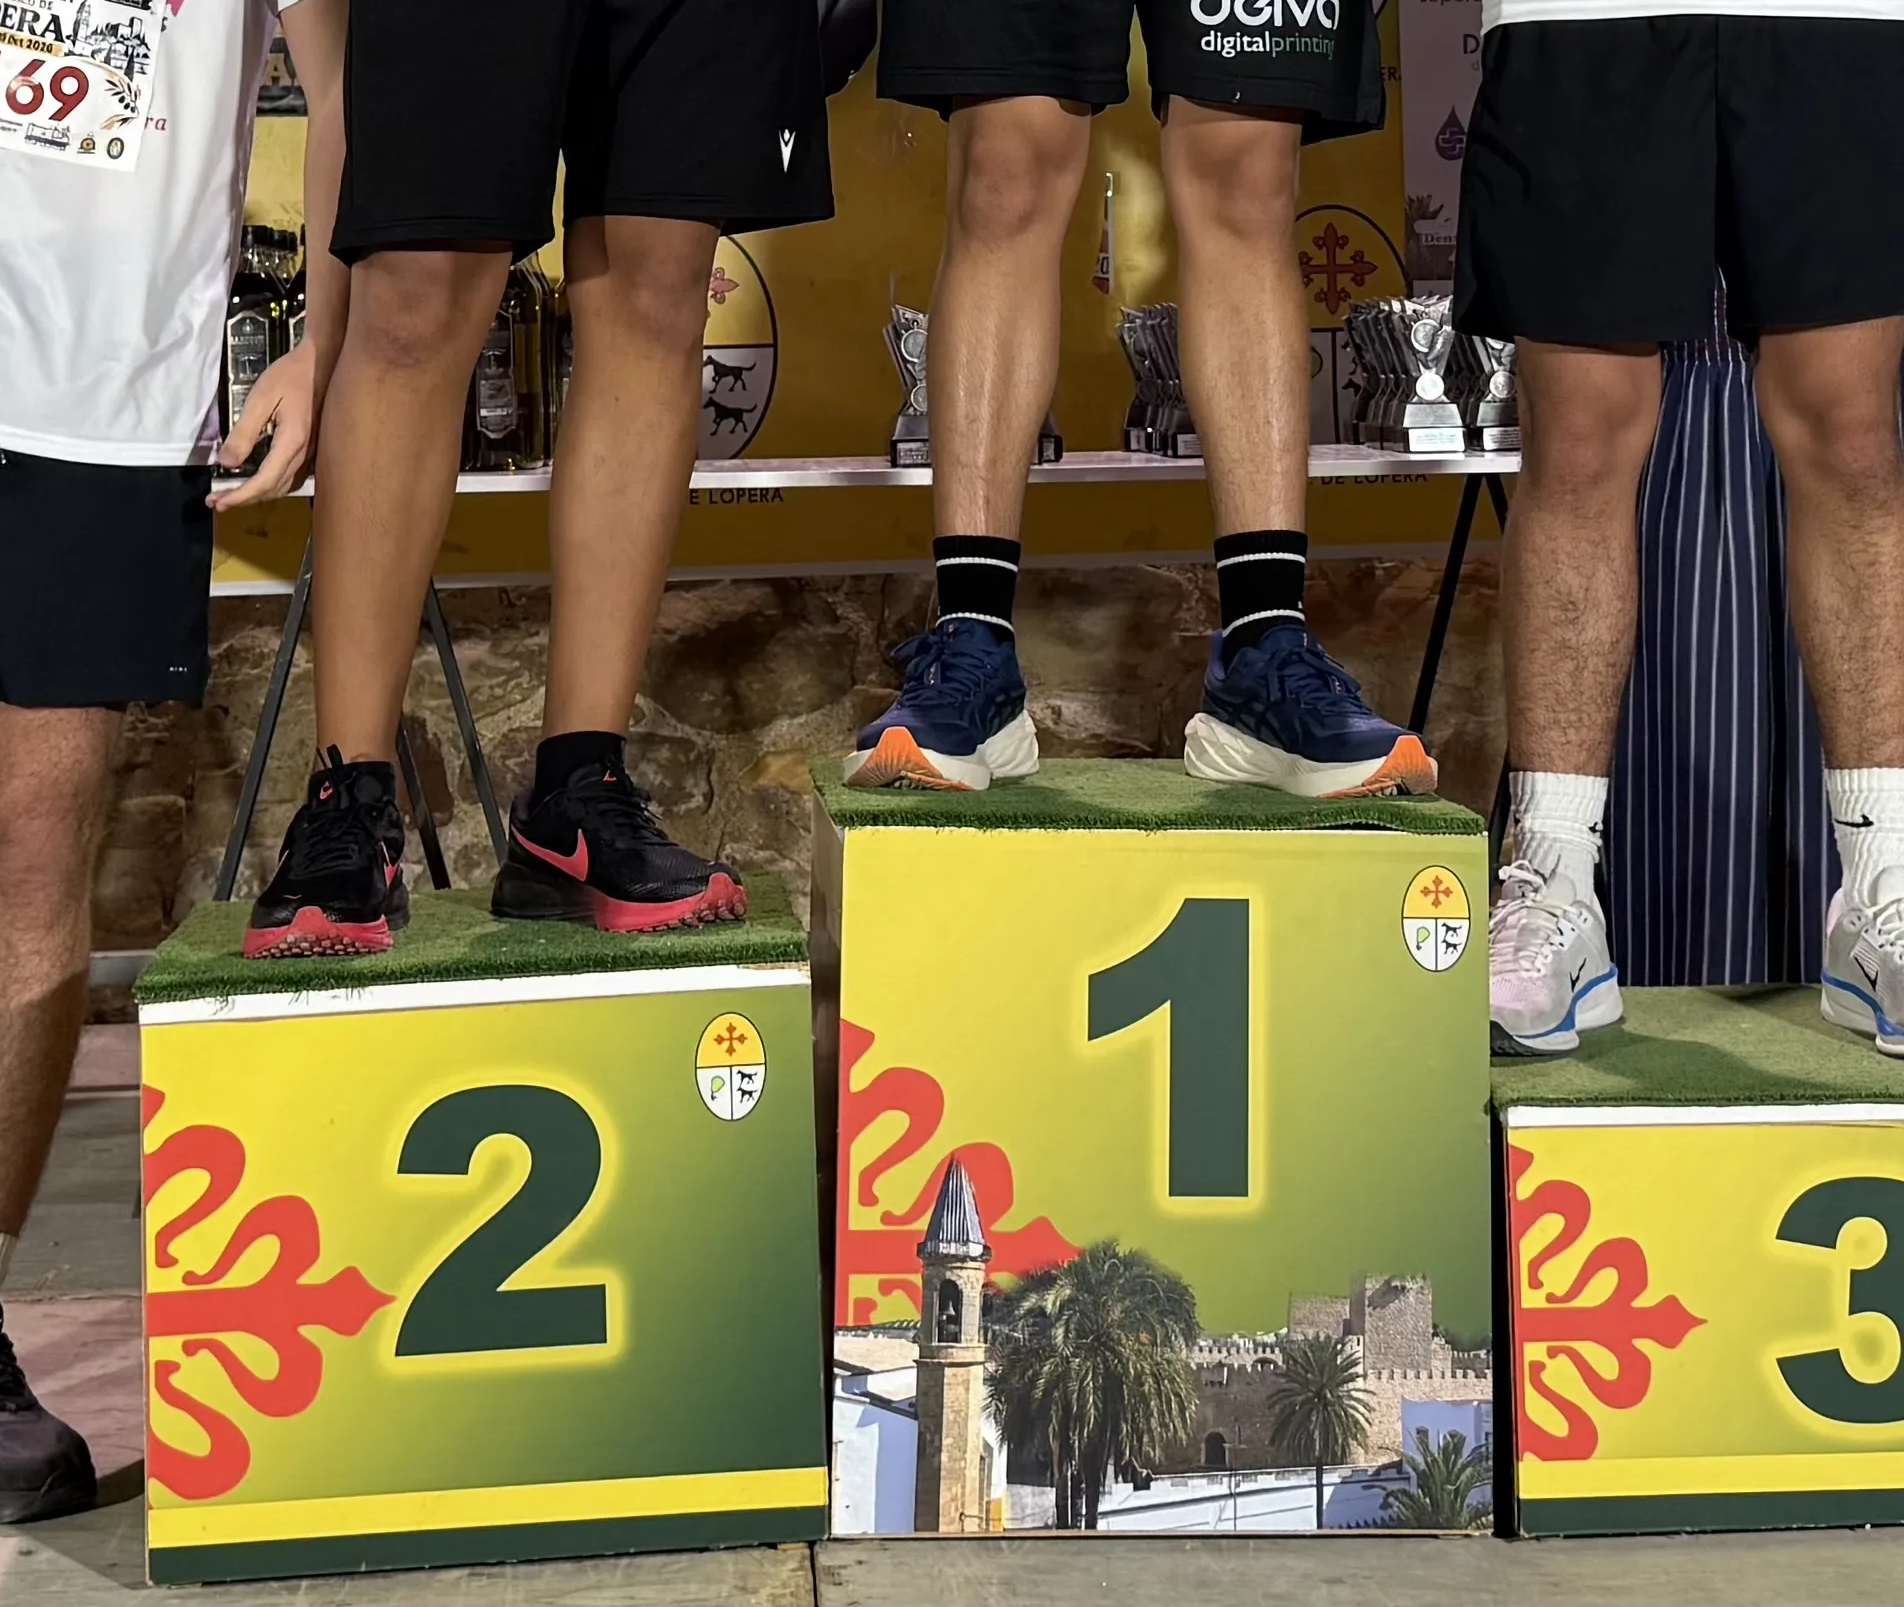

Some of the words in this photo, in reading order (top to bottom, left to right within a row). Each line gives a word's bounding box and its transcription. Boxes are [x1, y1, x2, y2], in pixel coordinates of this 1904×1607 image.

[708, 487, 785, 505] LOPERA
[1087, 897, 1250, 1198] 1
[394, 1083, 608, 1358] 2
